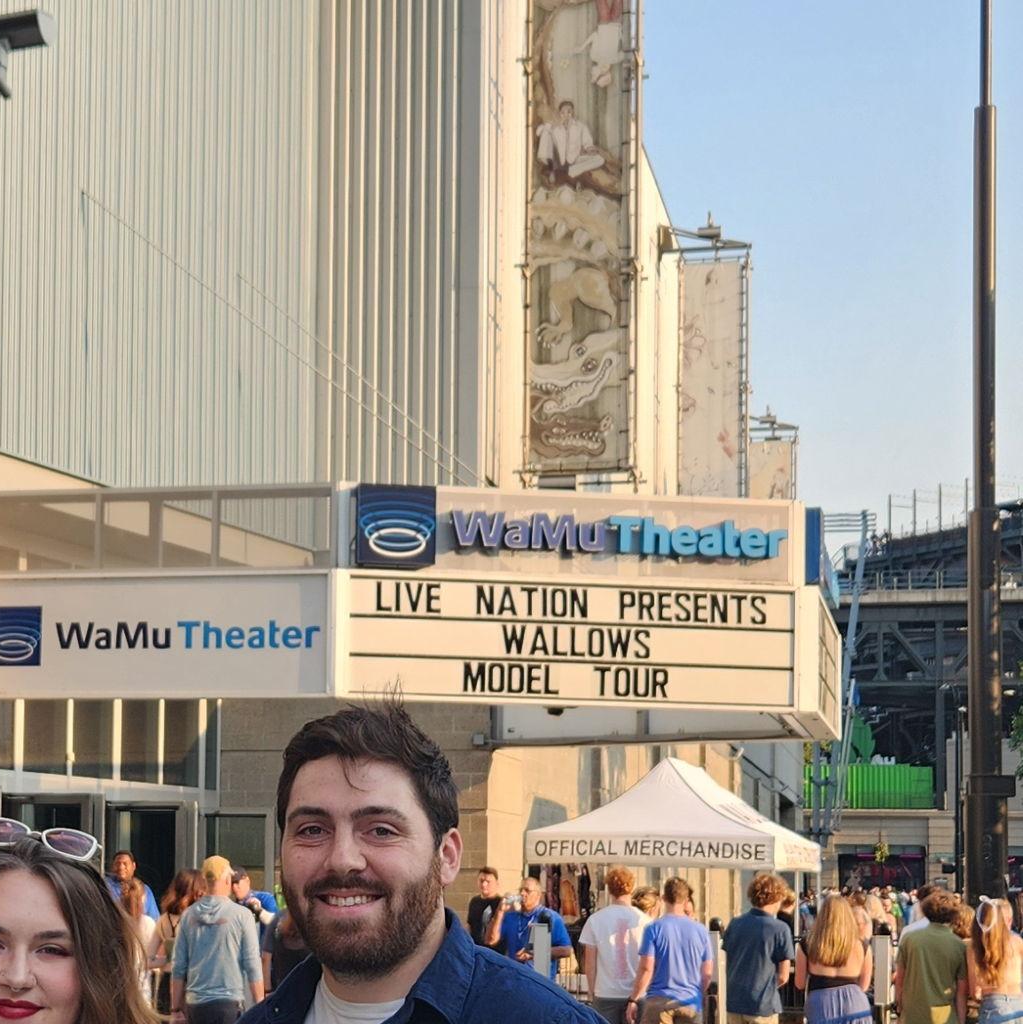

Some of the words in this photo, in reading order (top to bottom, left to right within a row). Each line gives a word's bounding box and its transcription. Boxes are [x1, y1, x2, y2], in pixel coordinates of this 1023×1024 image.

[451, 508, 607, 552] WaMu
[609, 515, 788, 559] Theater
[375, 580, 441, 613] LIVE
[476, 585, 588, 618] NATION
[619, 590, 767, 625] PRESENTS
[55, 621, 171, 650] WaMu
[177, 620, 321, 649] Theater
[502, 624, 651, 660] WALLOWS
[463, 662, 559, 695] MODEL
[593, 666, 669, 698] TOUR
[534, 839, 617, 856] OFFICIAL
[624, 839, 766, 861] MERCHANDISE
